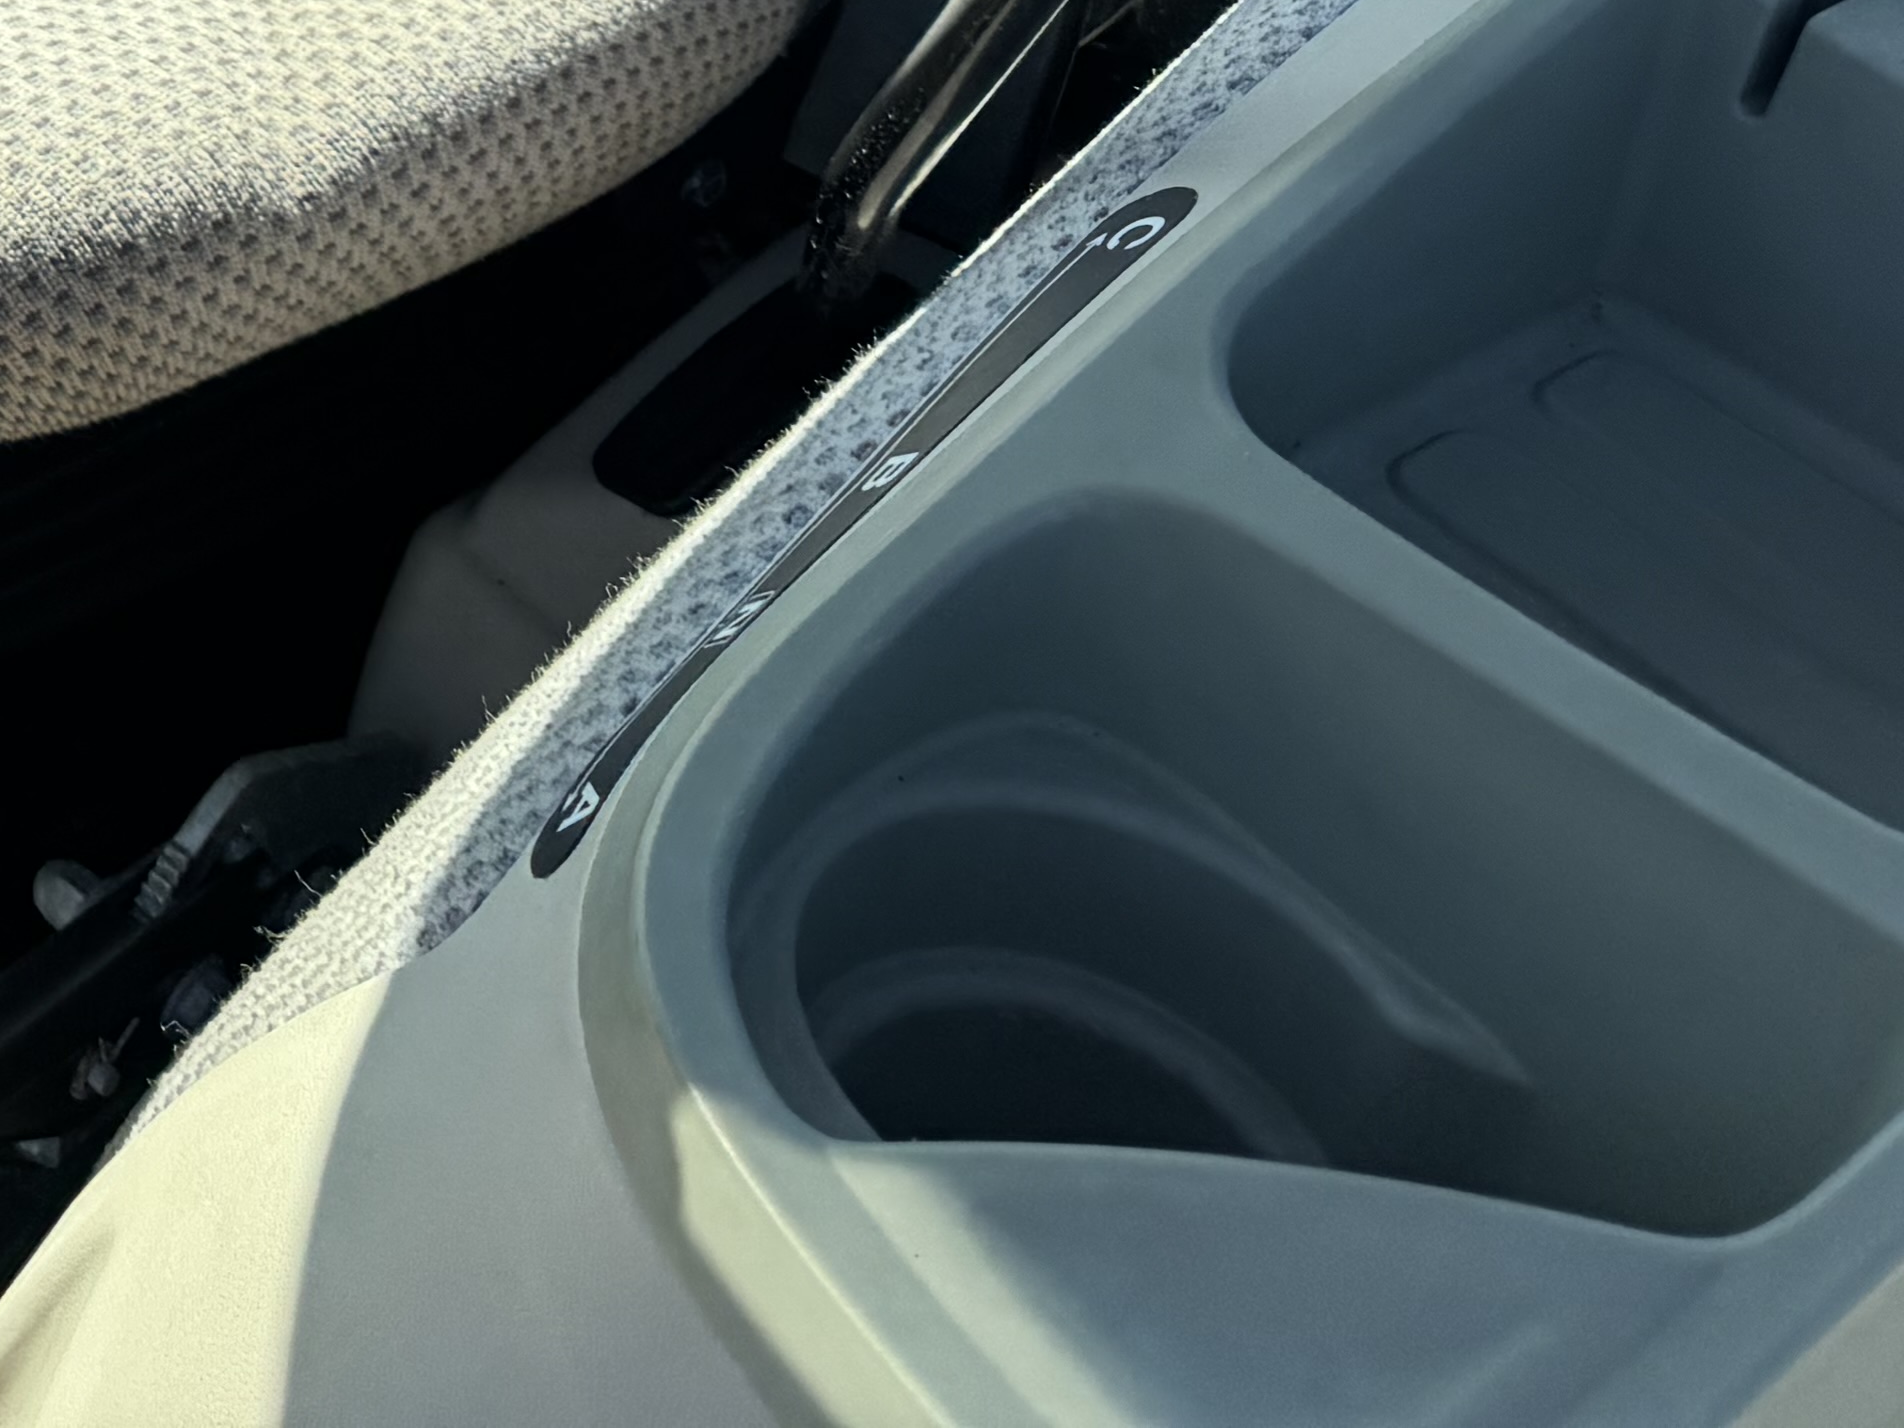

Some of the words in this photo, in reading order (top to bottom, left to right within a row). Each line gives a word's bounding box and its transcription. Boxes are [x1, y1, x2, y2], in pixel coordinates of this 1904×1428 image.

[1106, 215, 1166, 251] C
[861, 451, 920, 492] B
[712, 598, 770, 642] N
[555, 781, 601, 833] A
